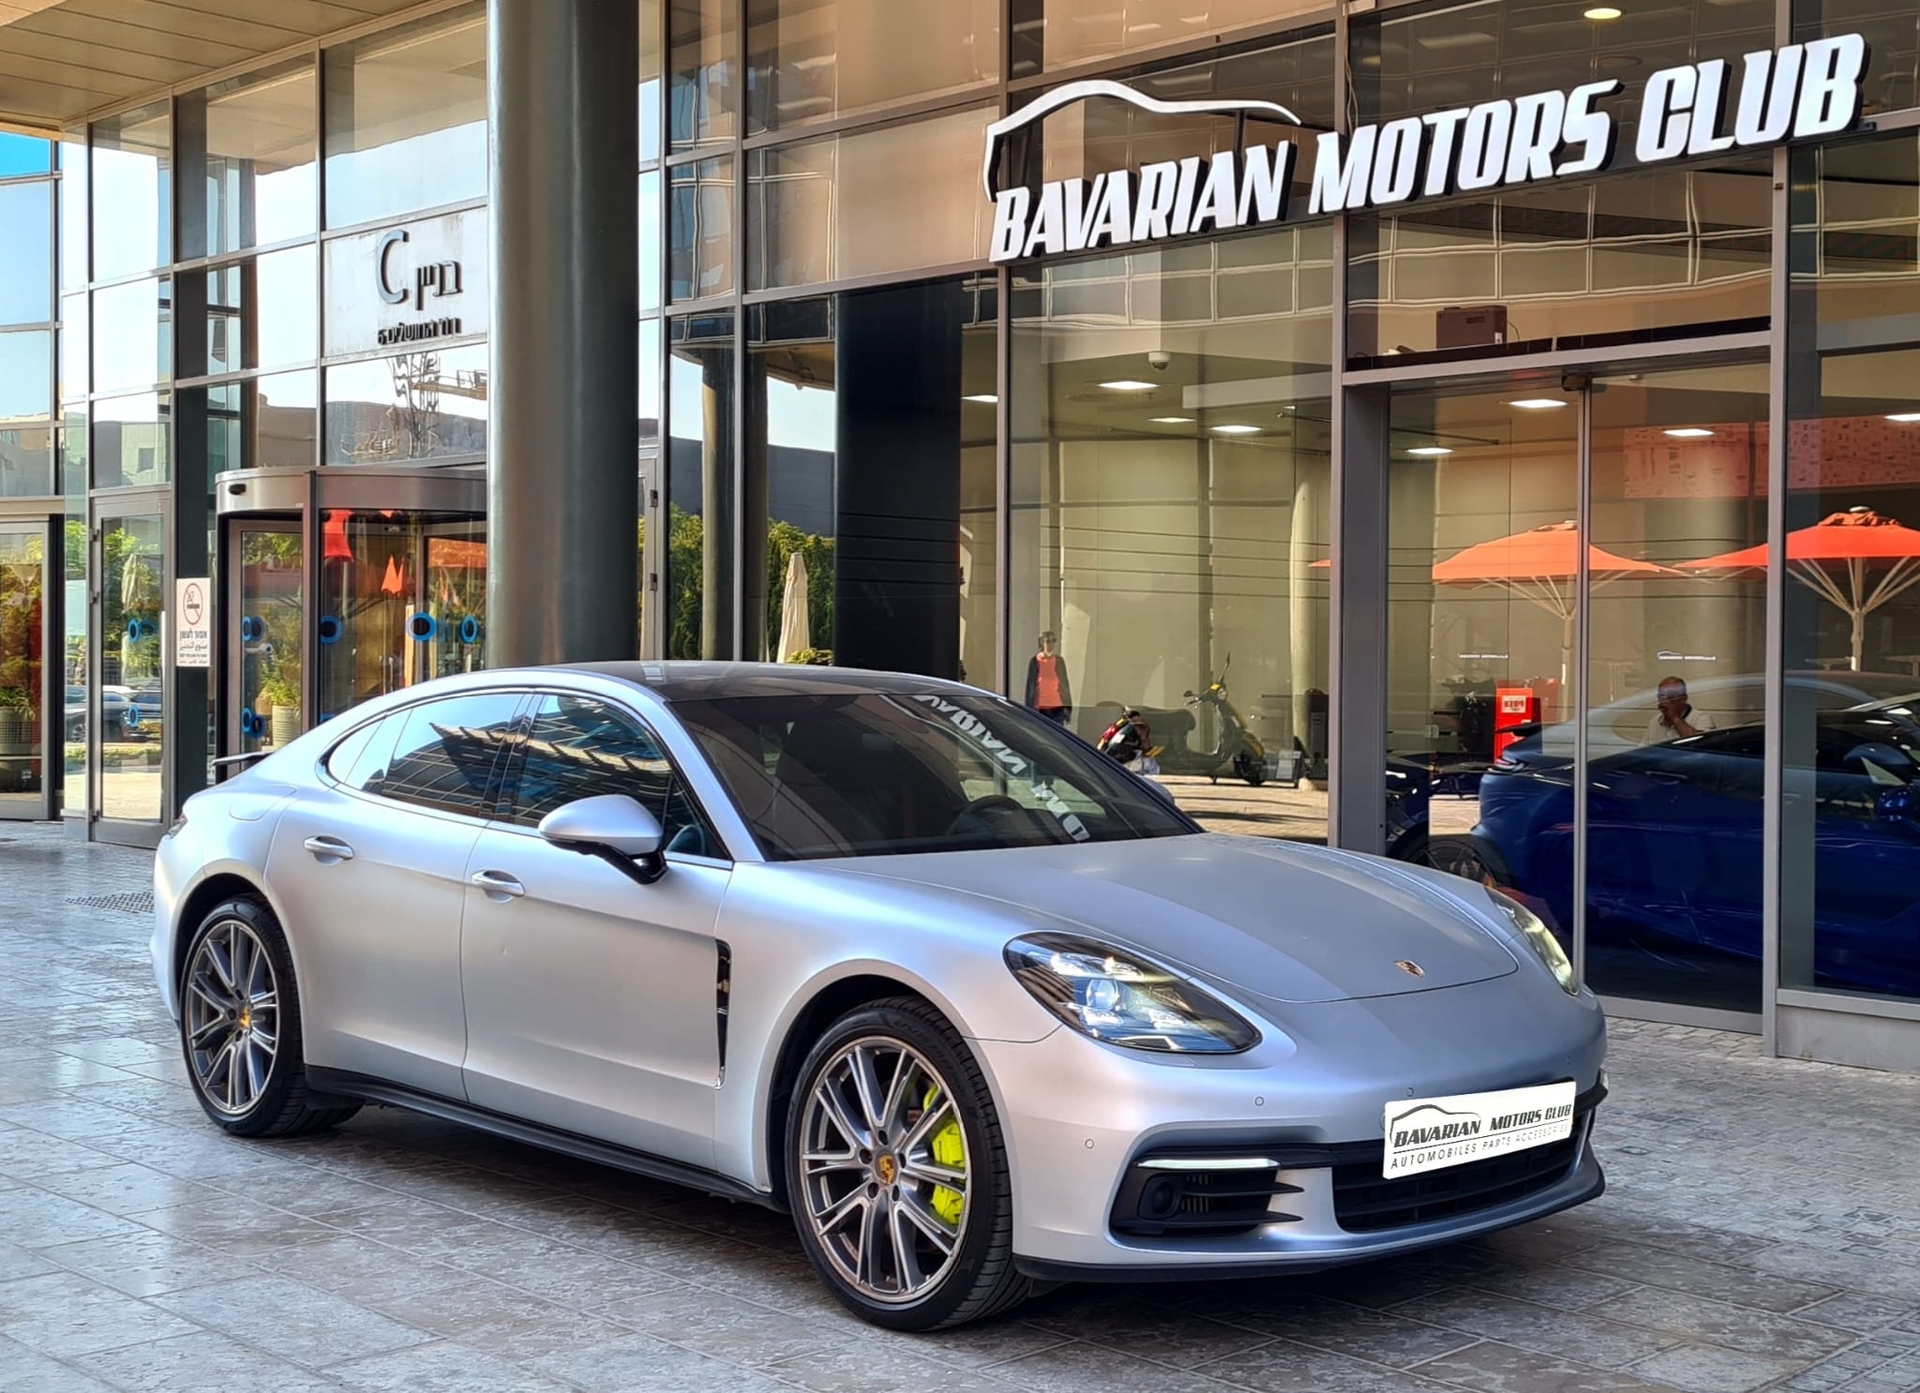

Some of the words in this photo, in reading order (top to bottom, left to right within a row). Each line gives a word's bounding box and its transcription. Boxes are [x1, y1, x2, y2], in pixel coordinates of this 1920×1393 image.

[989, 140, 1292, 263] BAVARIAN
[1308, 79, 1621, 214] MOTORS
[1636, 33, 1867, 162] CLUB
[376, 229, 409, 305] C
[1394, 1120, 1481, 1148] BAVARIAN
[1489, 1109, 1542, 1131] MOTORS
[1544, 1103, 1572, 1120] CLUB
[1390, 1142, 1477, 1170] AUTOMOBILES
